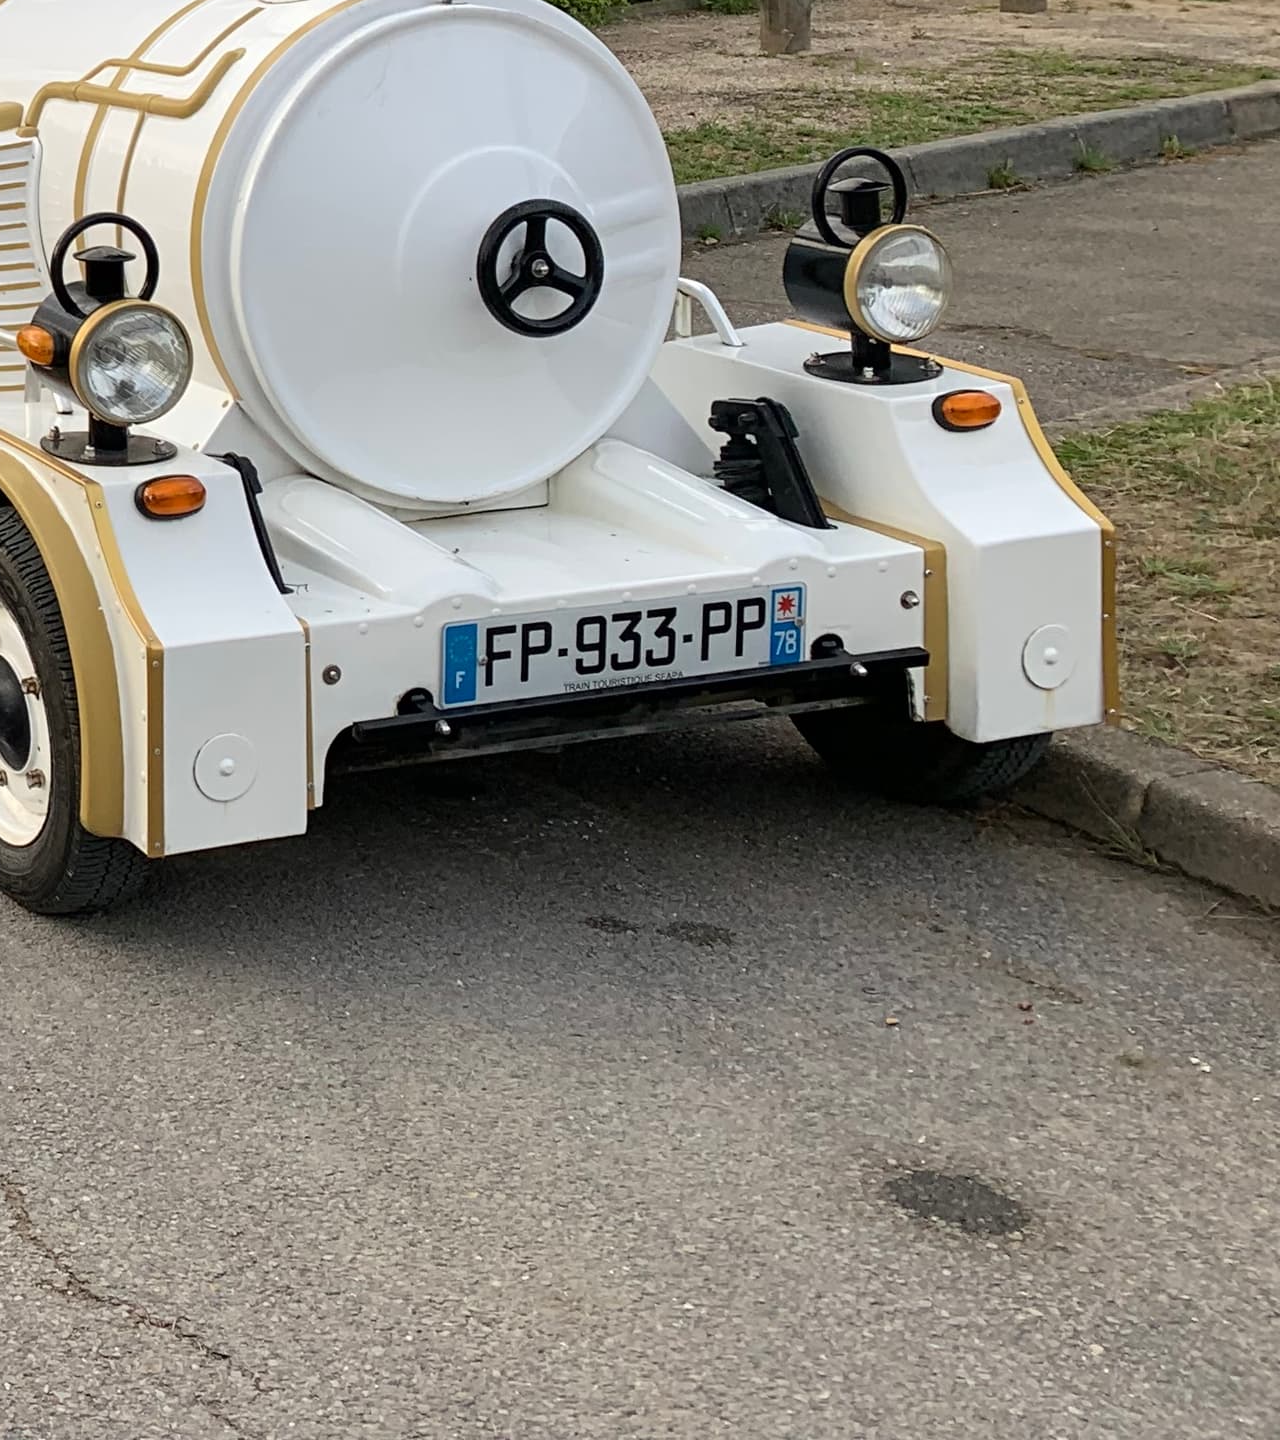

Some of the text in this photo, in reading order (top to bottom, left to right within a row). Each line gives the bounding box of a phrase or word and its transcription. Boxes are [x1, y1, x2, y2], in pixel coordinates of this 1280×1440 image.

[485, 597, 766, 687] FP-933-PP
[774, 629, 797, 656] 78
[455, 671, 467, 689] F
[564, 681, 590, 692] TRAIN
